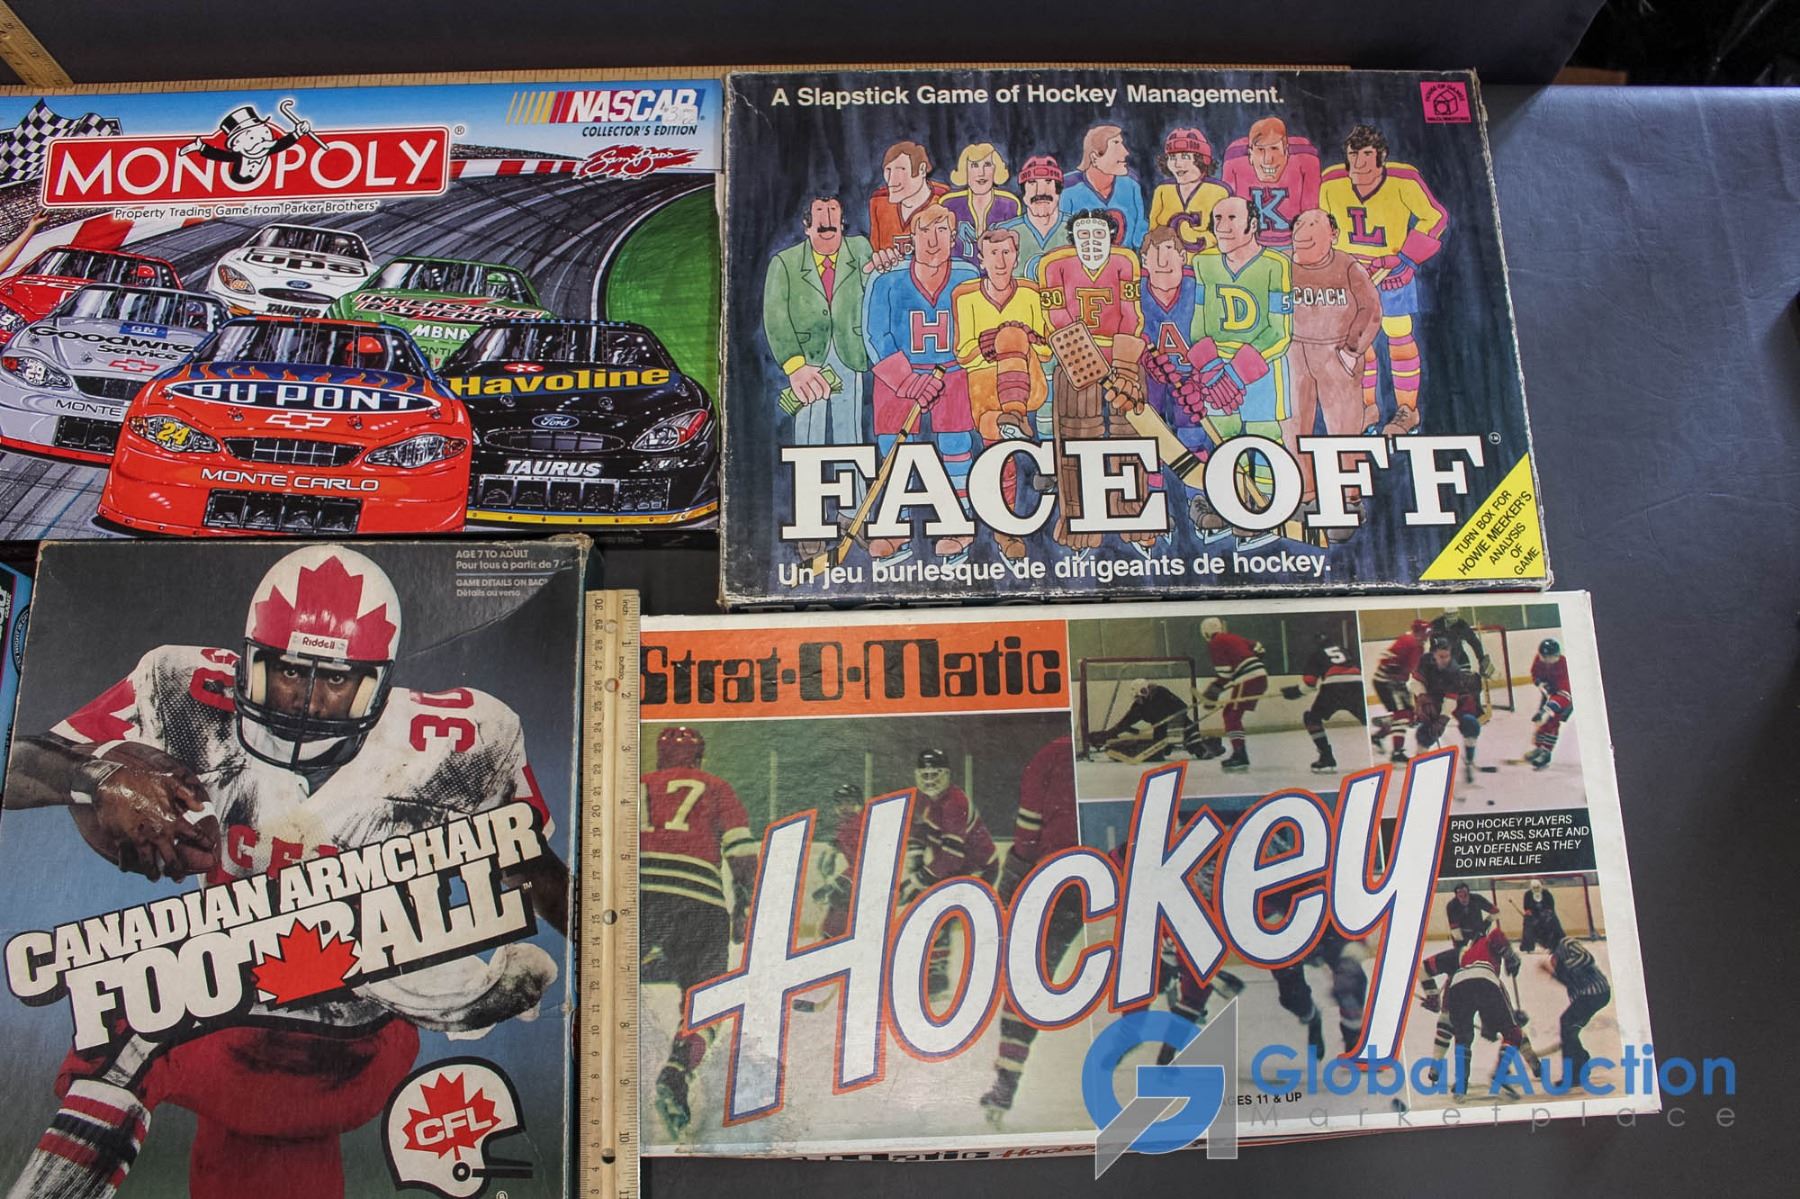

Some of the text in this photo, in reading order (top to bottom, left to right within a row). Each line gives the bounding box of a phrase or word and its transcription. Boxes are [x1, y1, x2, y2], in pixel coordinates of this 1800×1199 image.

[771, 84, 1284, 109] A Slapstick Game of Hockey Management.
[582, 125, 698, 137] COLLECTOR'S EDITION
[55, 139, 438, 196] MONOPOLY
[115, 208, 165, 219] Property
[170, 206, 211, 218] Trading
[215, 205, 248, 216] Game
[253, 203, 281, 214] from
[284, 202, 321, 214] Parker
[1249, 187, 1289, 230] K
[1347, 206, 1388, 247] L
[1041, 289, 1063, 306] 30
[1292, 287, 1348, 306] COACH
[266, 303, 322, 317] TAURUS
[357, 303, 495, 322] BATTERI
[1075, 288, 1113, 329] F
[1216, 284, 1261, 333] D
[29, 326, 194, 354] Goodwre
[131, 325, 158, 335] GM
[909, 310, 951, 354] H
[1157, 322, 1191, 366] A
[449, 369, 672, 398] Havoline
[55, 399, 122, 418] MONTE
[540, 415, 570, 428] Ford
[157, 423, 190, 445] 24
[504, 459, 602, 478] TAURUS
[201, 468, 380, 492] MONTE CARLO
[780, 434, 1486, 541] FACE OFF
[1454, 490, 1512, 554] TURN BOX FOR
[1458, 490, 1532, 575] HOWIE MEEKER'S
[456, 550, 529, 559] AGE 7 TO ADULT
[1489, 522, 1526, 565] ANALYSIS
[1510, 543, 1525, 559] OF
[456, 561, 478, 570] Pour
[538, 560, 552, 568] de
[778, 550, 1332, 589] Un jeu burlesque de dirigeants de hockey.
[1513, 546, 1540, 575] GAME
[456, 579, 480, 587] GAME
[302, 636, 336, 649] Riddell
[1451, 815, 1573, 830] PRO HOCKEY PLAYERS
[1452, 826, 1589, 843] SHOOT, PASS, SKATE AND
[1454, 839, 1582, 856] PLAY DEFENSE AS THEY
[1455, 854, 1542, 868] DO IN REAL LIFE
[4, 801, 542, 999] CANADIAN ARMCHAIR
[682, 746, 1459, 1127] Hockey
[1256, 1094, 1268, 1104] 11
[1273, 1094, 1281, 1103] &
[1285, 1092, 1302, 1103] UP
[414, 1109, 496, 1146] CFL
